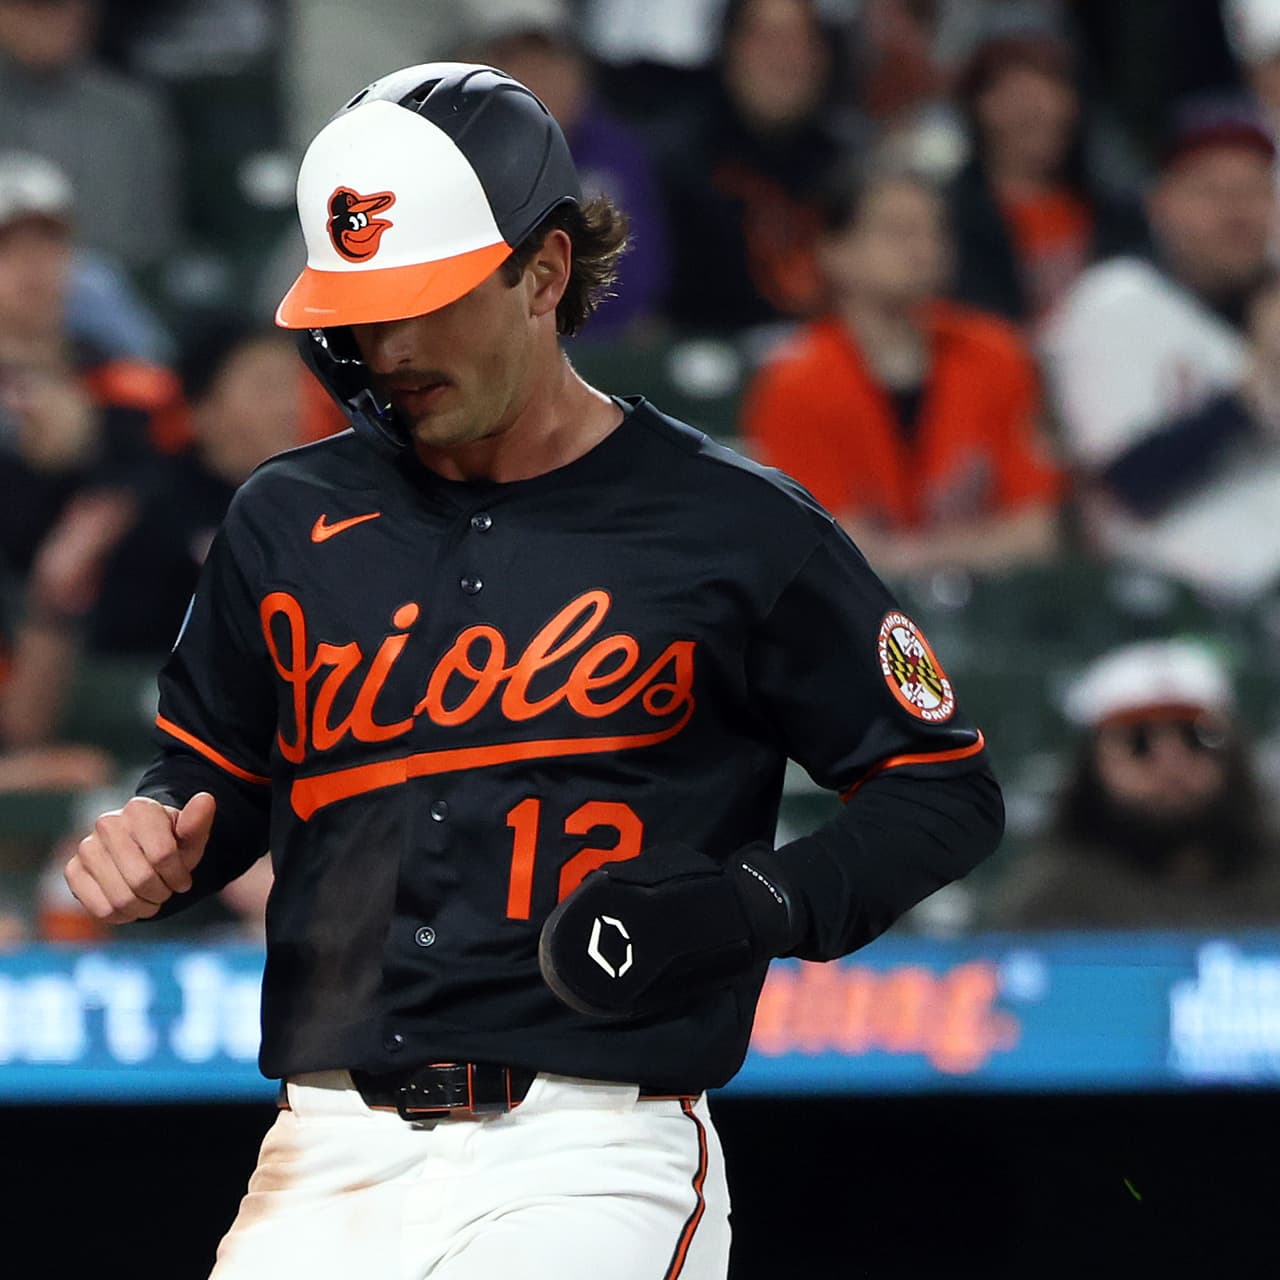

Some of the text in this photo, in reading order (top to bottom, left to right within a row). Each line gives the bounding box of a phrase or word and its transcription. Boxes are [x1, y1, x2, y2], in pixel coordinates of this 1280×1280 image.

[259, 590, 697, 764] Orioles
[878, 614, 918, 676] BALTIMORE
[920, 677, 954, 721] ORIOLES
[505, 798, 644, 920] 12
